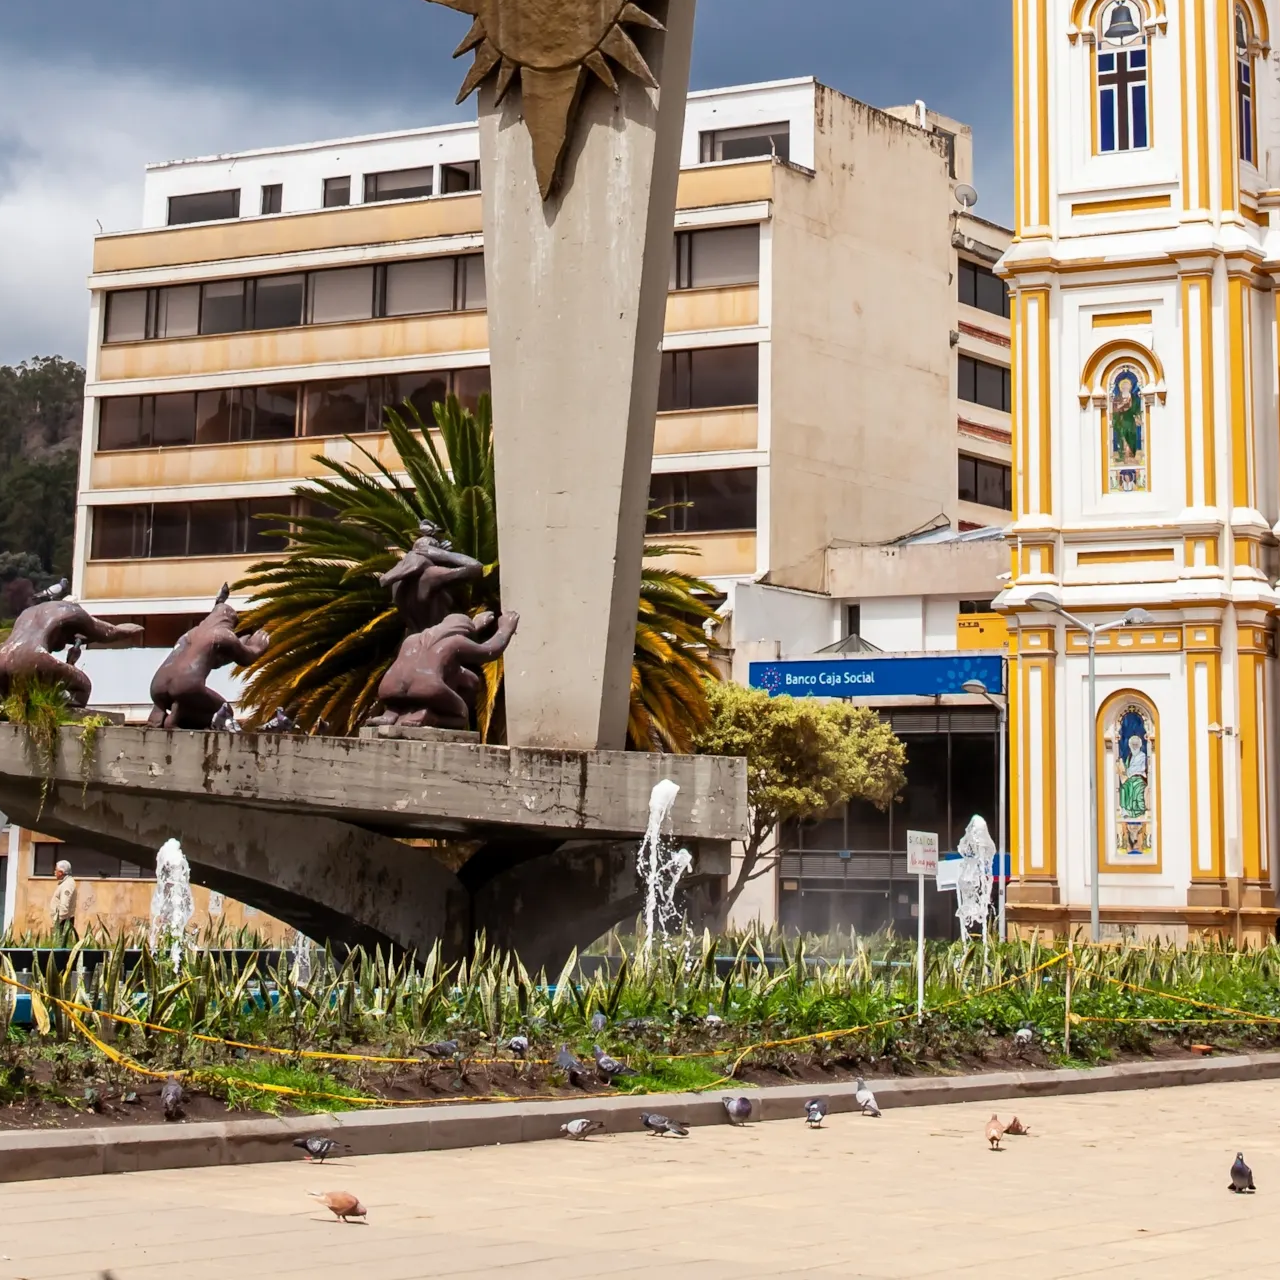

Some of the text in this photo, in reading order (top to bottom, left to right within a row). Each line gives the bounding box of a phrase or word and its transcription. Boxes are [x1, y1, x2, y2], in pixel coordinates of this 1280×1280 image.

[785, 671, 875, 686] Banco Caja Social
